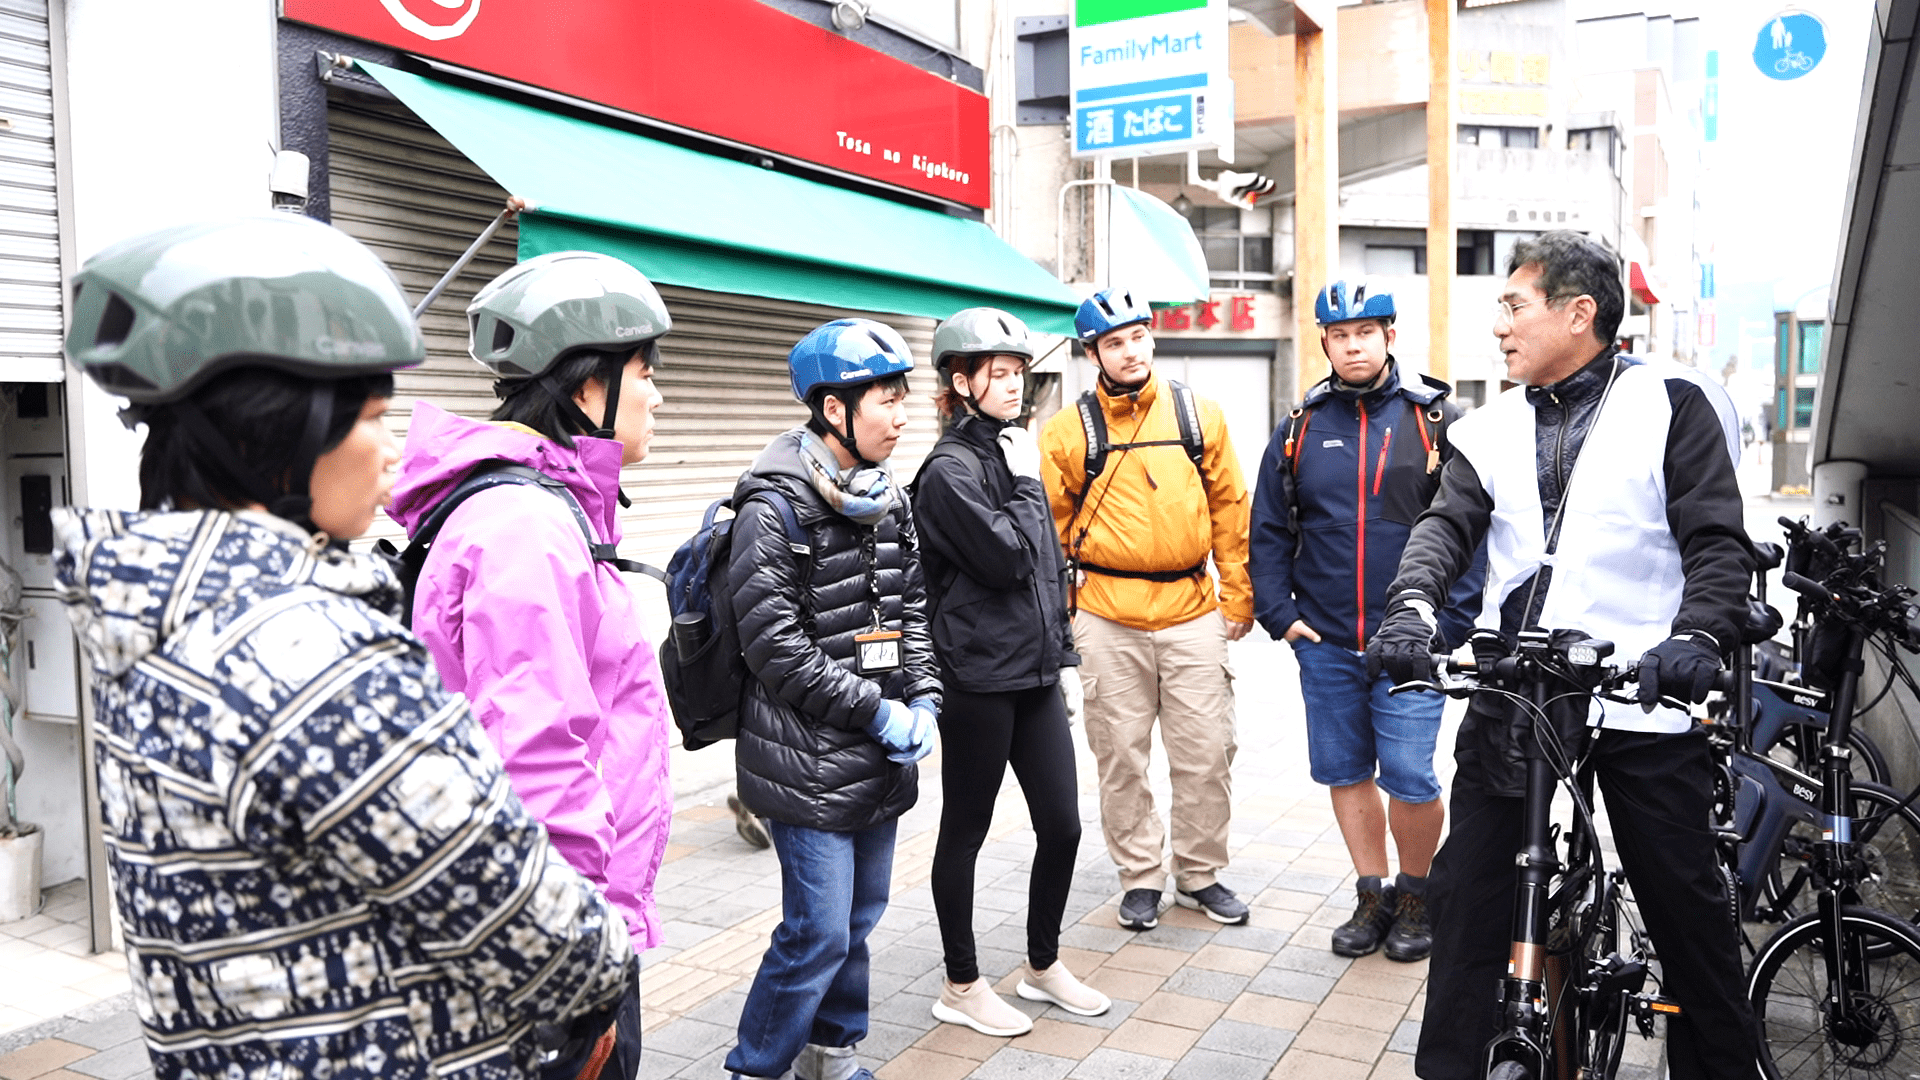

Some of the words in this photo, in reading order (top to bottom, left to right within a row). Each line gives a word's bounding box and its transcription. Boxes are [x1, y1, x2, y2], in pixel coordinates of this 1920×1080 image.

[1081, 31, 1202, 66] FamilyMart
[1086, 108, 1114, 144] 酒
[1123, 105, 1183, 138] たばこ
[836, 131, 871, 155] Tosa
[883, 149, 901, 163] no
[912, 154, 970, 184] Kigokoro
